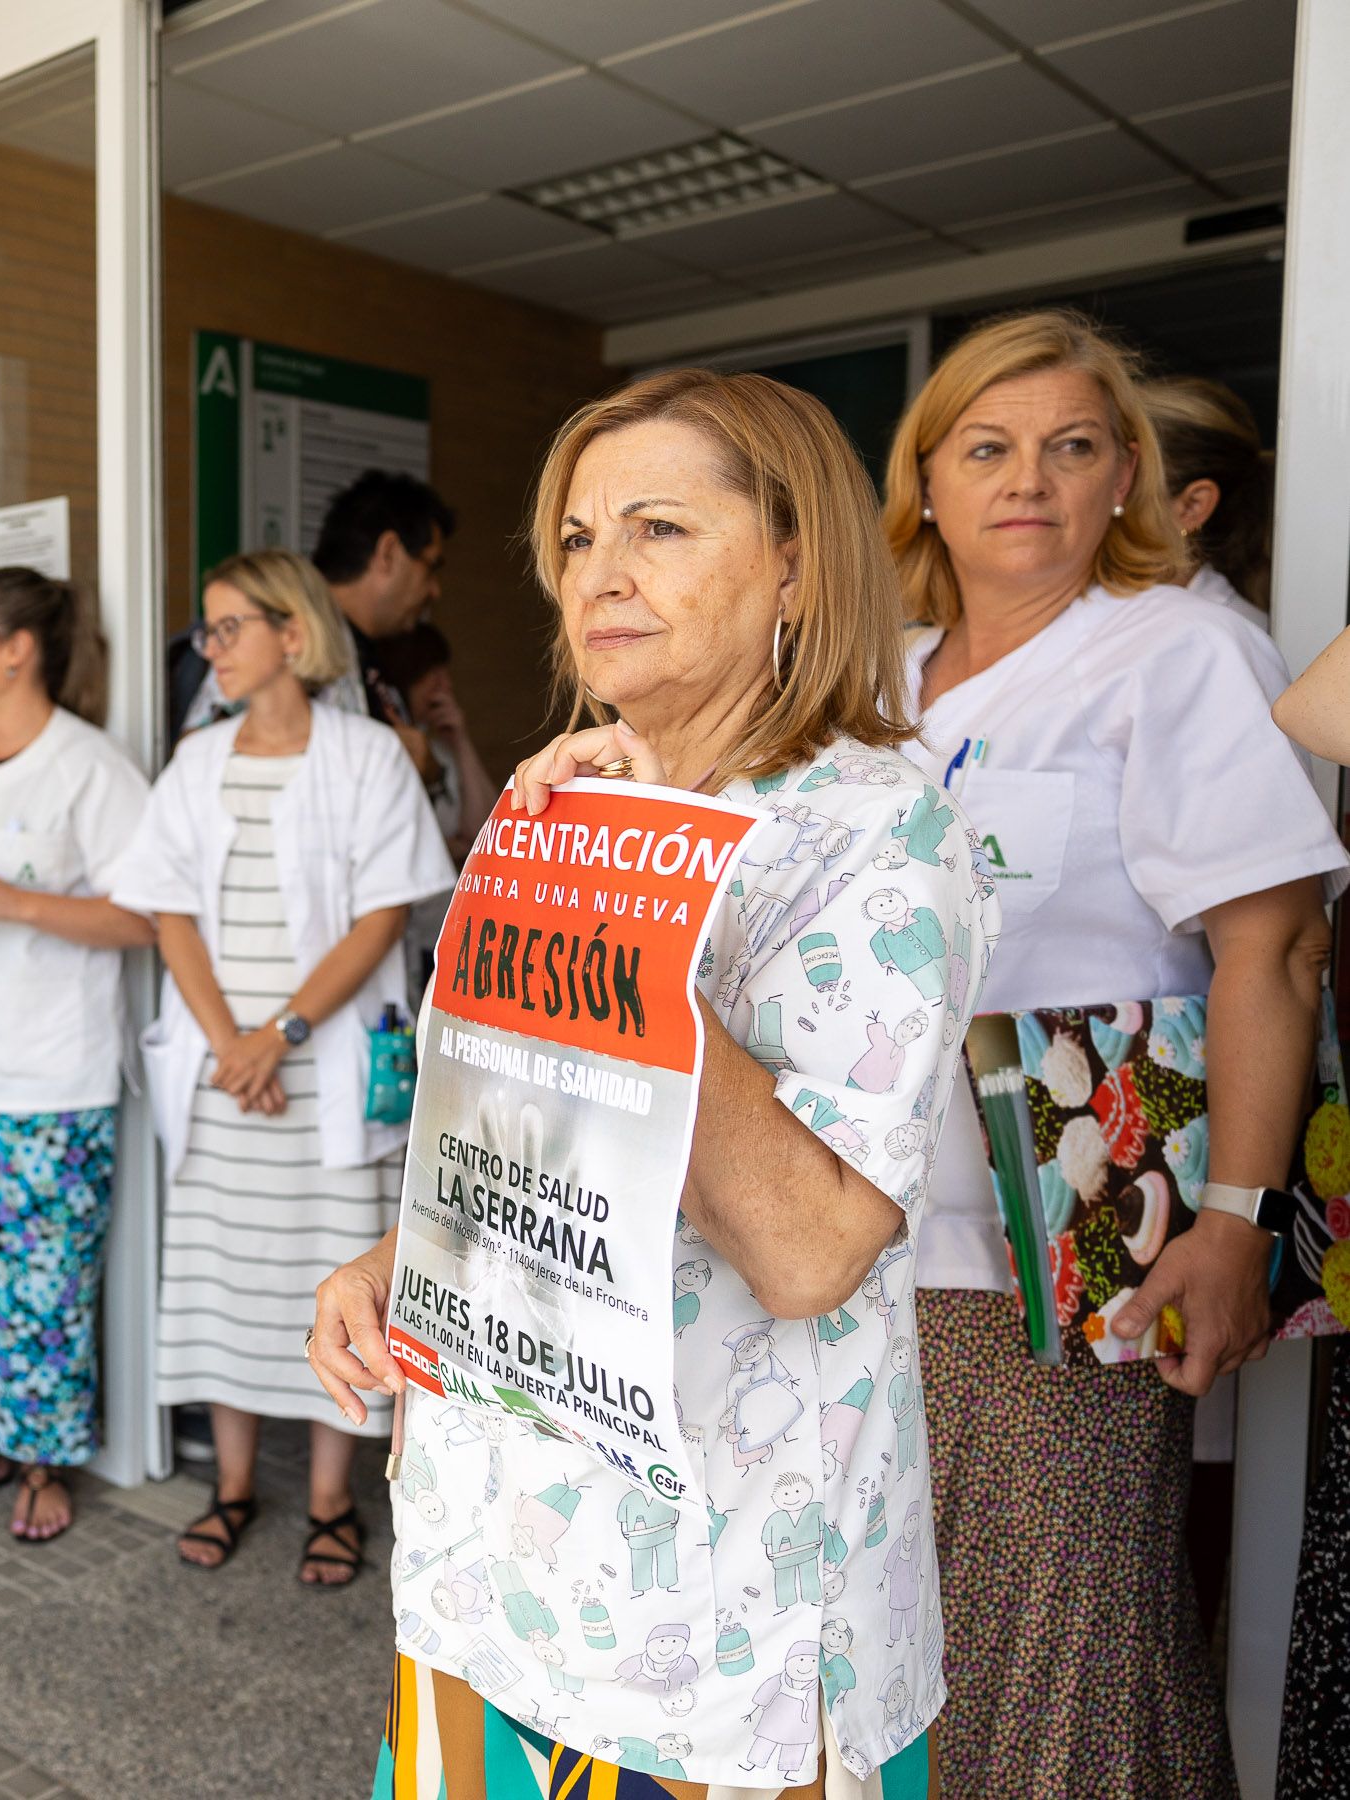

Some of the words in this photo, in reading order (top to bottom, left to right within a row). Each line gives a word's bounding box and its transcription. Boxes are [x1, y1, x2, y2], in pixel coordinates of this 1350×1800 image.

[459, 873, 519, 900] CONTRA
[534, 882, 579, 909] UNA
[593, 890, 689, 926] NUEVA
[470, 818, 734, 883] ONCENTRACIÓN
[452, 915, 646, 1038] AGRESIÓN
[439, 1026, 453, 1057] AL
[454, 1030, 530, 1082] PERSONAL
[533, 1053, 557, 1090] DE
[560, 1060, 653, 1116] SANIDAD
[437, 1166, 466, 1215] LA
[471, 1183, 615, 1284] SERRANA
[439, 1132, 503, 1181] CENTRO
[508, 1160, 533, 1195] DE
[537, 1173, 610, 1223] SALUD
[411, 1198, 440, 1223] Avenida
[441, 1214, 454, 1230] del
[454, 1220, 481, 1248] Mosto,
[509, 1248, 535, 1274] 11404
[535, 1261, 562, 1286] Jerez
[564, 1275, 580, 1293] de
[582, 1280, 593, 1298] la
[596, 1287, 649, 1321] Frontera
[394, 1301, 401, 1318] A
[403, 1306, 422, 1330] LAS
[425, 1319, 453, 1348] 11.00
[456, 1336, 464, 1356] H
[467, 1343, 483, 1368] EN
[486, 1354, 502, 1380] LA
[505, 1367, 569, 1409] PUERTA
[573, 1398, 668, 1454] PRINCIPAL
[398, 1265, 475, 1341] JUEVES,
[484, 1314, 509, 1354] 18
[517, 1330, 556, 1377] DE
[563, 1351, 656, 1422] JULIO
[654, 1472, 687, 1495] CSIF
